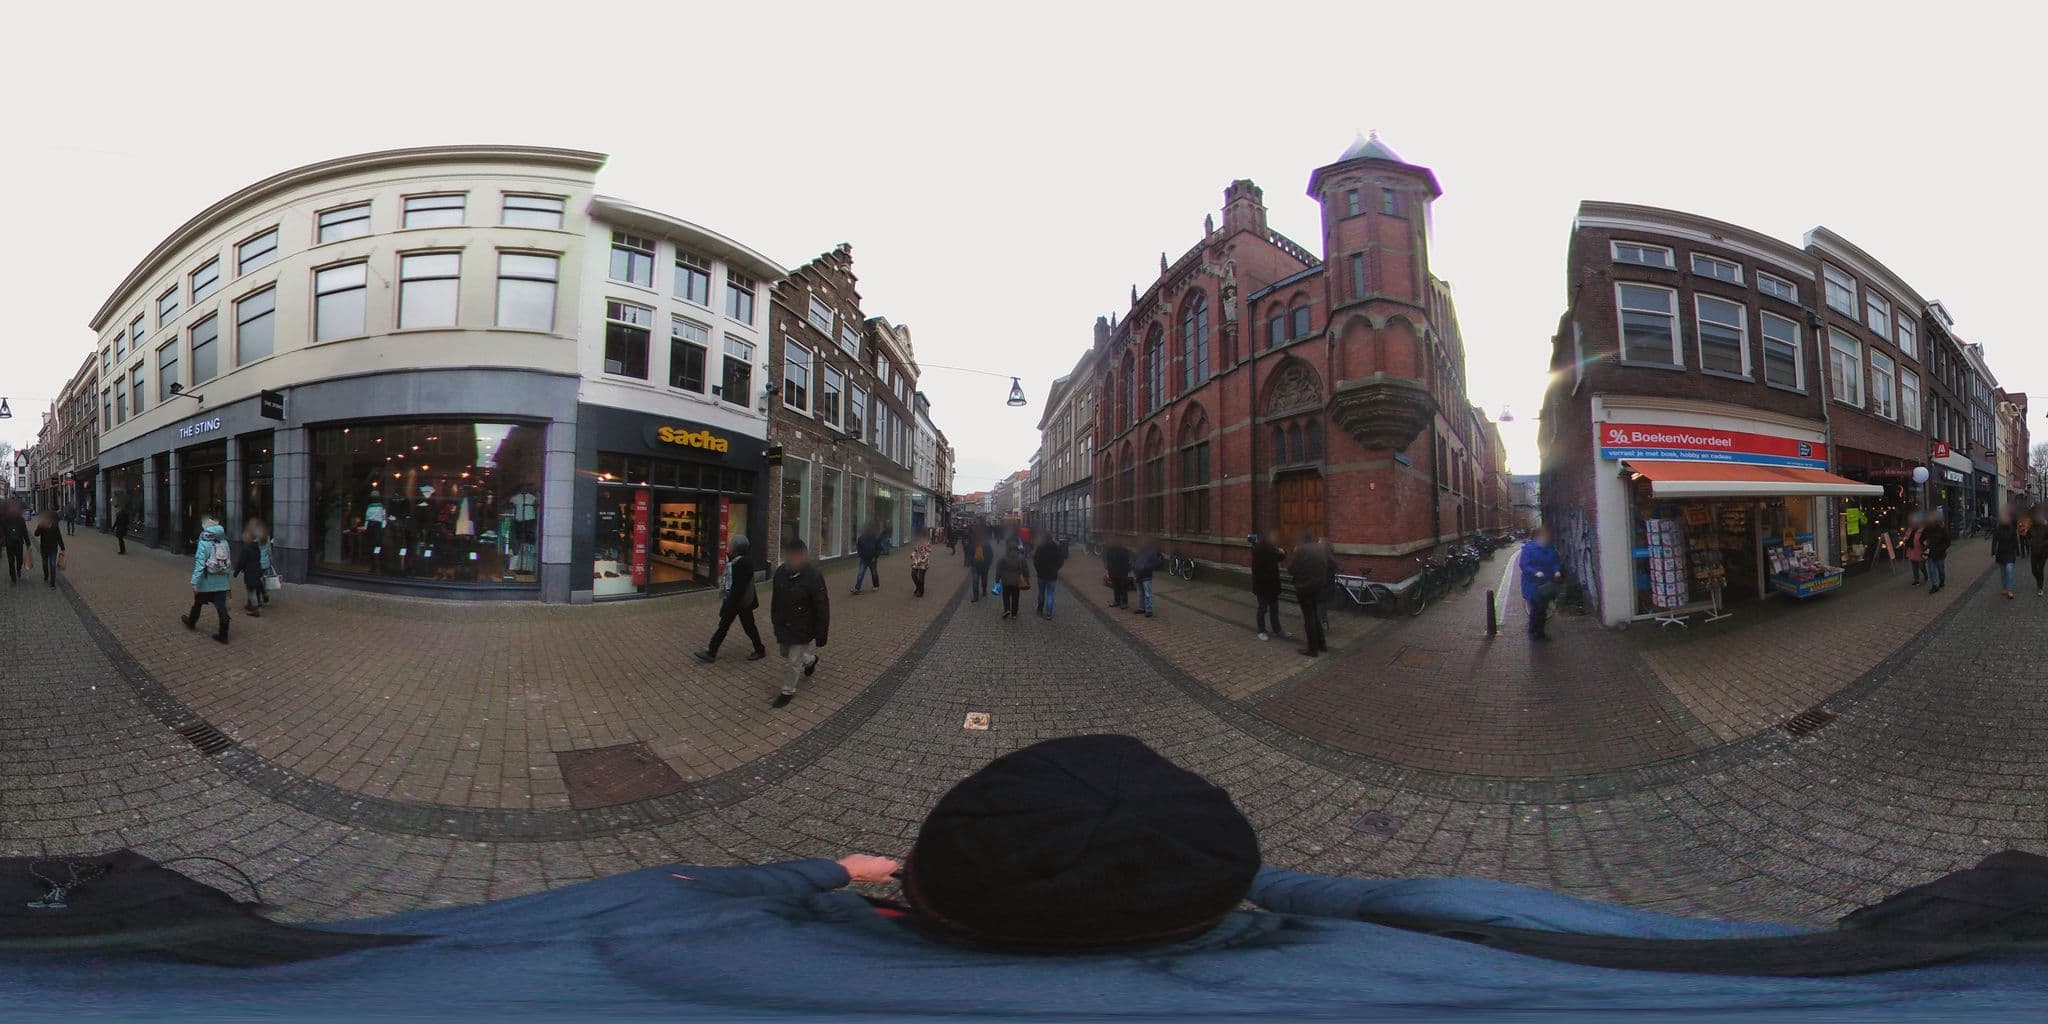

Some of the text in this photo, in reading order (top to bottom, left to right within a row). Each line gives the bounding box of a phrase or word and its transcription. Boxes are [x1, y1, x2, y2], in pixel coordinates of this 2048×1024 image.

[180, 417, 221, 438] THE STING
[658, 426, 728, 453] sacha
[1632, 431, 1732, 447] BoekenVoordeel
[1637, 450, 1644, 458] je
[1680, 452, 1700, 460] hobby
